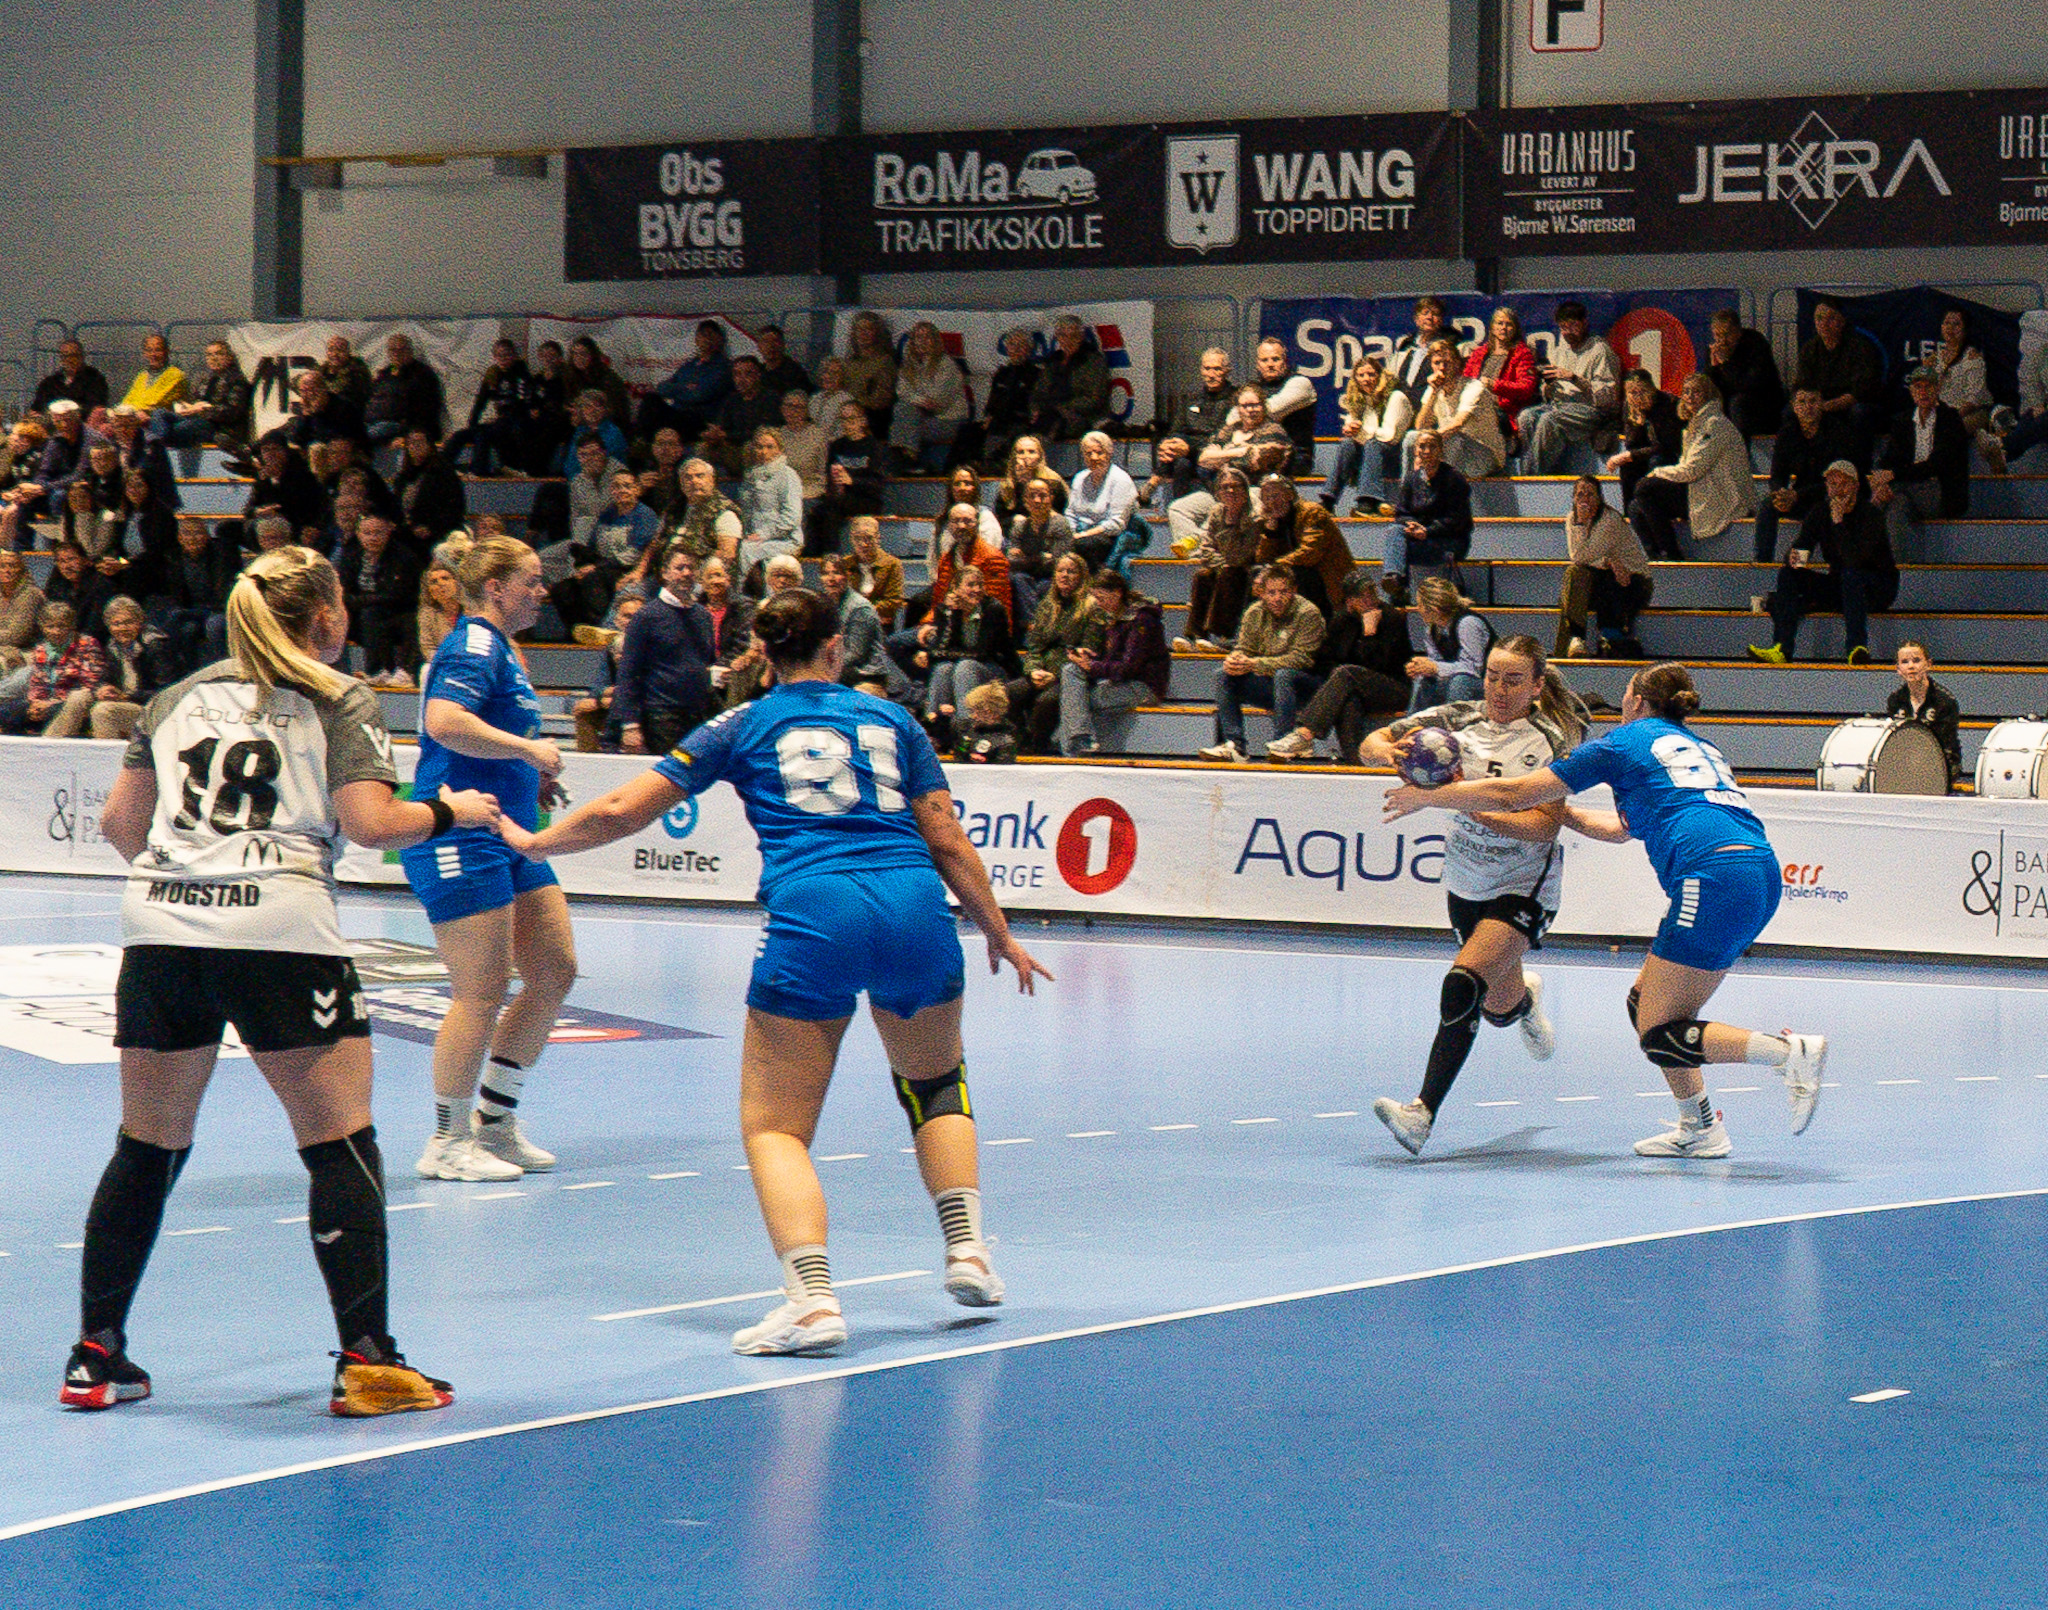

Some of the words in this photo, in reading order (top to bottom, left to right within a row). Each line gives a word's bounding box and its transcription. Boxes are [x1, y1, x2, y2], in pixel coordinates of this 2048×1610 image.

[660, 152, 724, 195] Obs
[1502, 130, 1636, 174] URBANHUS
[1678, 139, 1952, 203] JEKRA
[874, 150, 1010, 204] RoMa
[1253, 149, 1416, 201] WANG
[1541, 176, 1579, 189] LEVERT
[1582, 176, 1598, 188] AV
[639, 200, 743, 249] BYGG
[875, 215, 1104, 253] TRAFIKKSKOLE
[1252, 204, 1416, 234] TOPPIDRETT
[1502, 216, 1549, 239] Bjarne
[174, 737, 282, 836] 18
[776, 726, 907, 816] 81
[634, 848, 721, 872] BlueTec
[1081, 815, 1113, 877] 1
[1235, 818, 1447, 891] Aqua
[2015, 851, 2048, 873] BA
[146, 881, 260, 907] MOGSTAD
[991, 864, 1045, 888] RGE
[1783, 864, 1824, 886] ers
